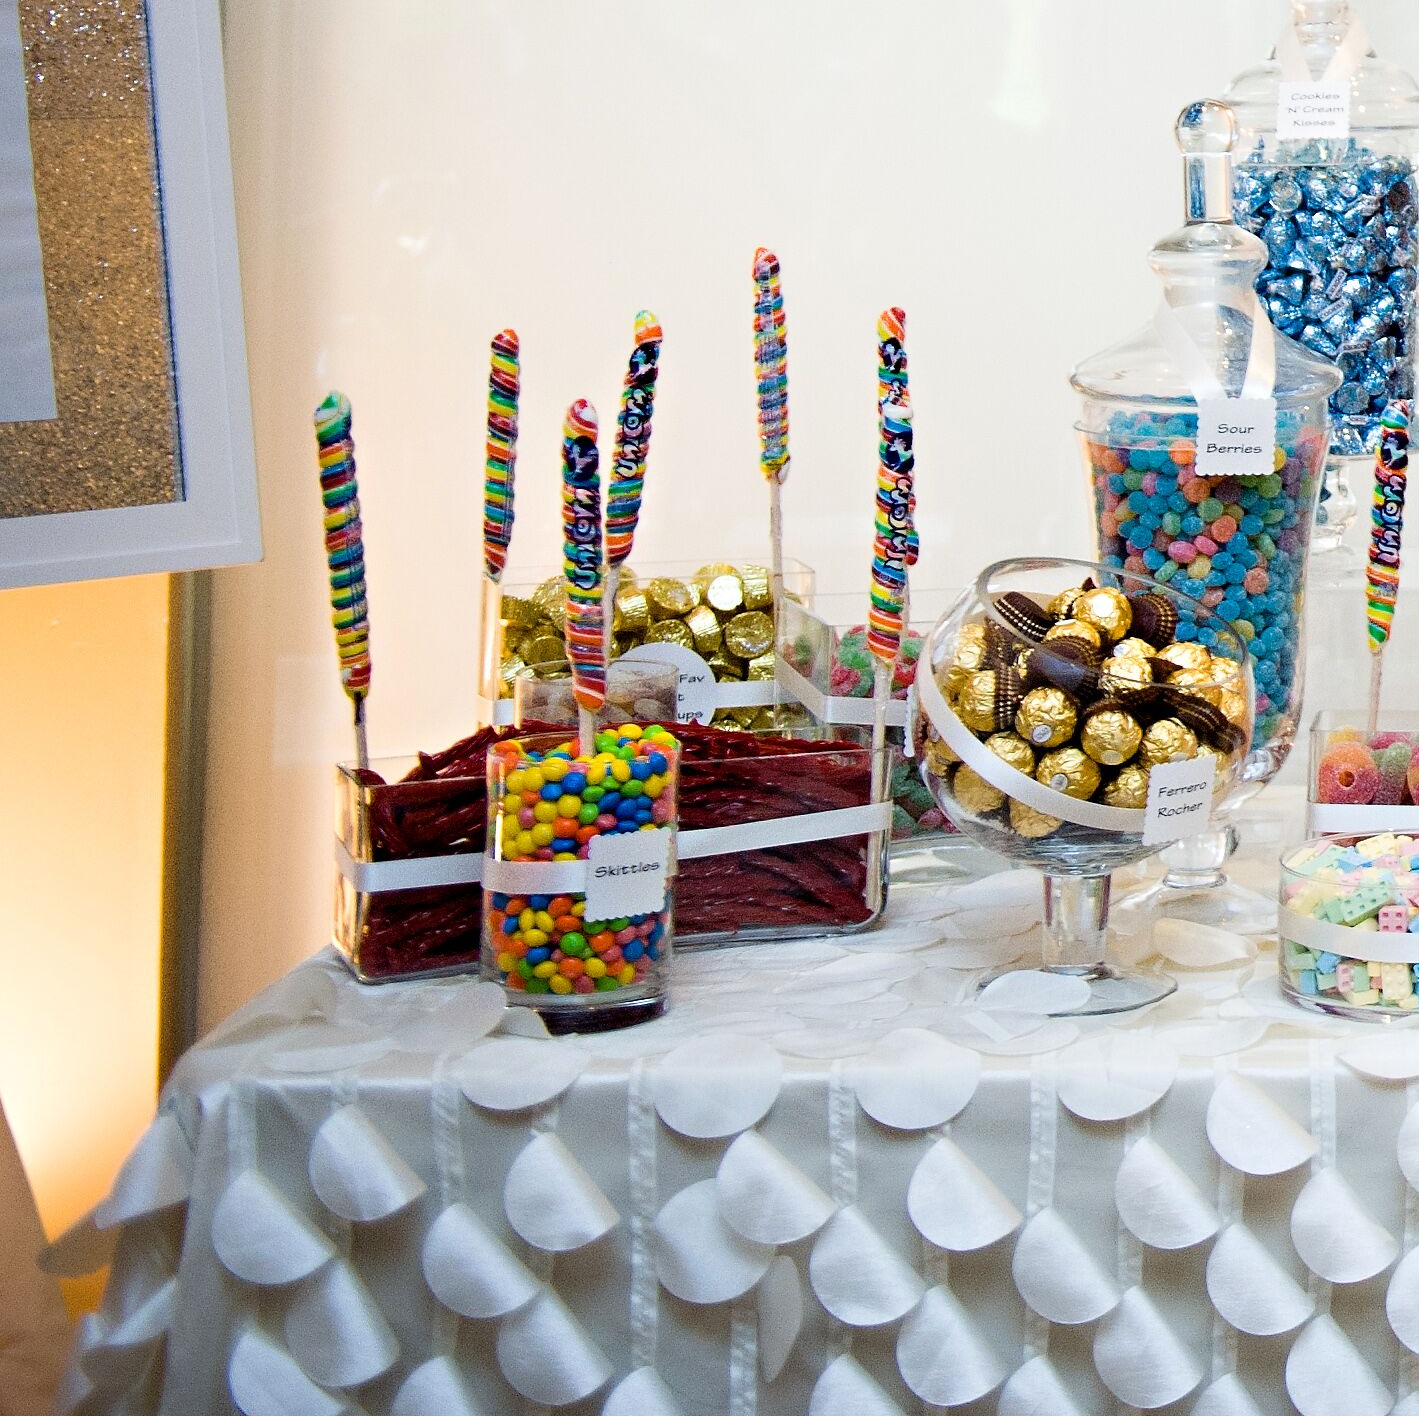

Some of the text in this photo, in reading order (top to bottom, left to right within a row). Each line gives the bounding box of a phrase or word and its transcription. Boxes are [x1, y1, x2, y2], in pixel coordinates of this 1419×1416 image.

[1290, 92, 1341, 101] Cookies
[1303, 105, 1344, 113] Cream
[1217, 423, 1255, 434] Sour
[1206, 443, 1263, 454] Berries
[679, 673, 705, 684] Fav
[677, 710, 704, 722] ups
[1158, 781, 1207, 798] Ferrero
[1157, 802, 1203, 818] Rocher
[594, 861, 660, 878] Skittles
